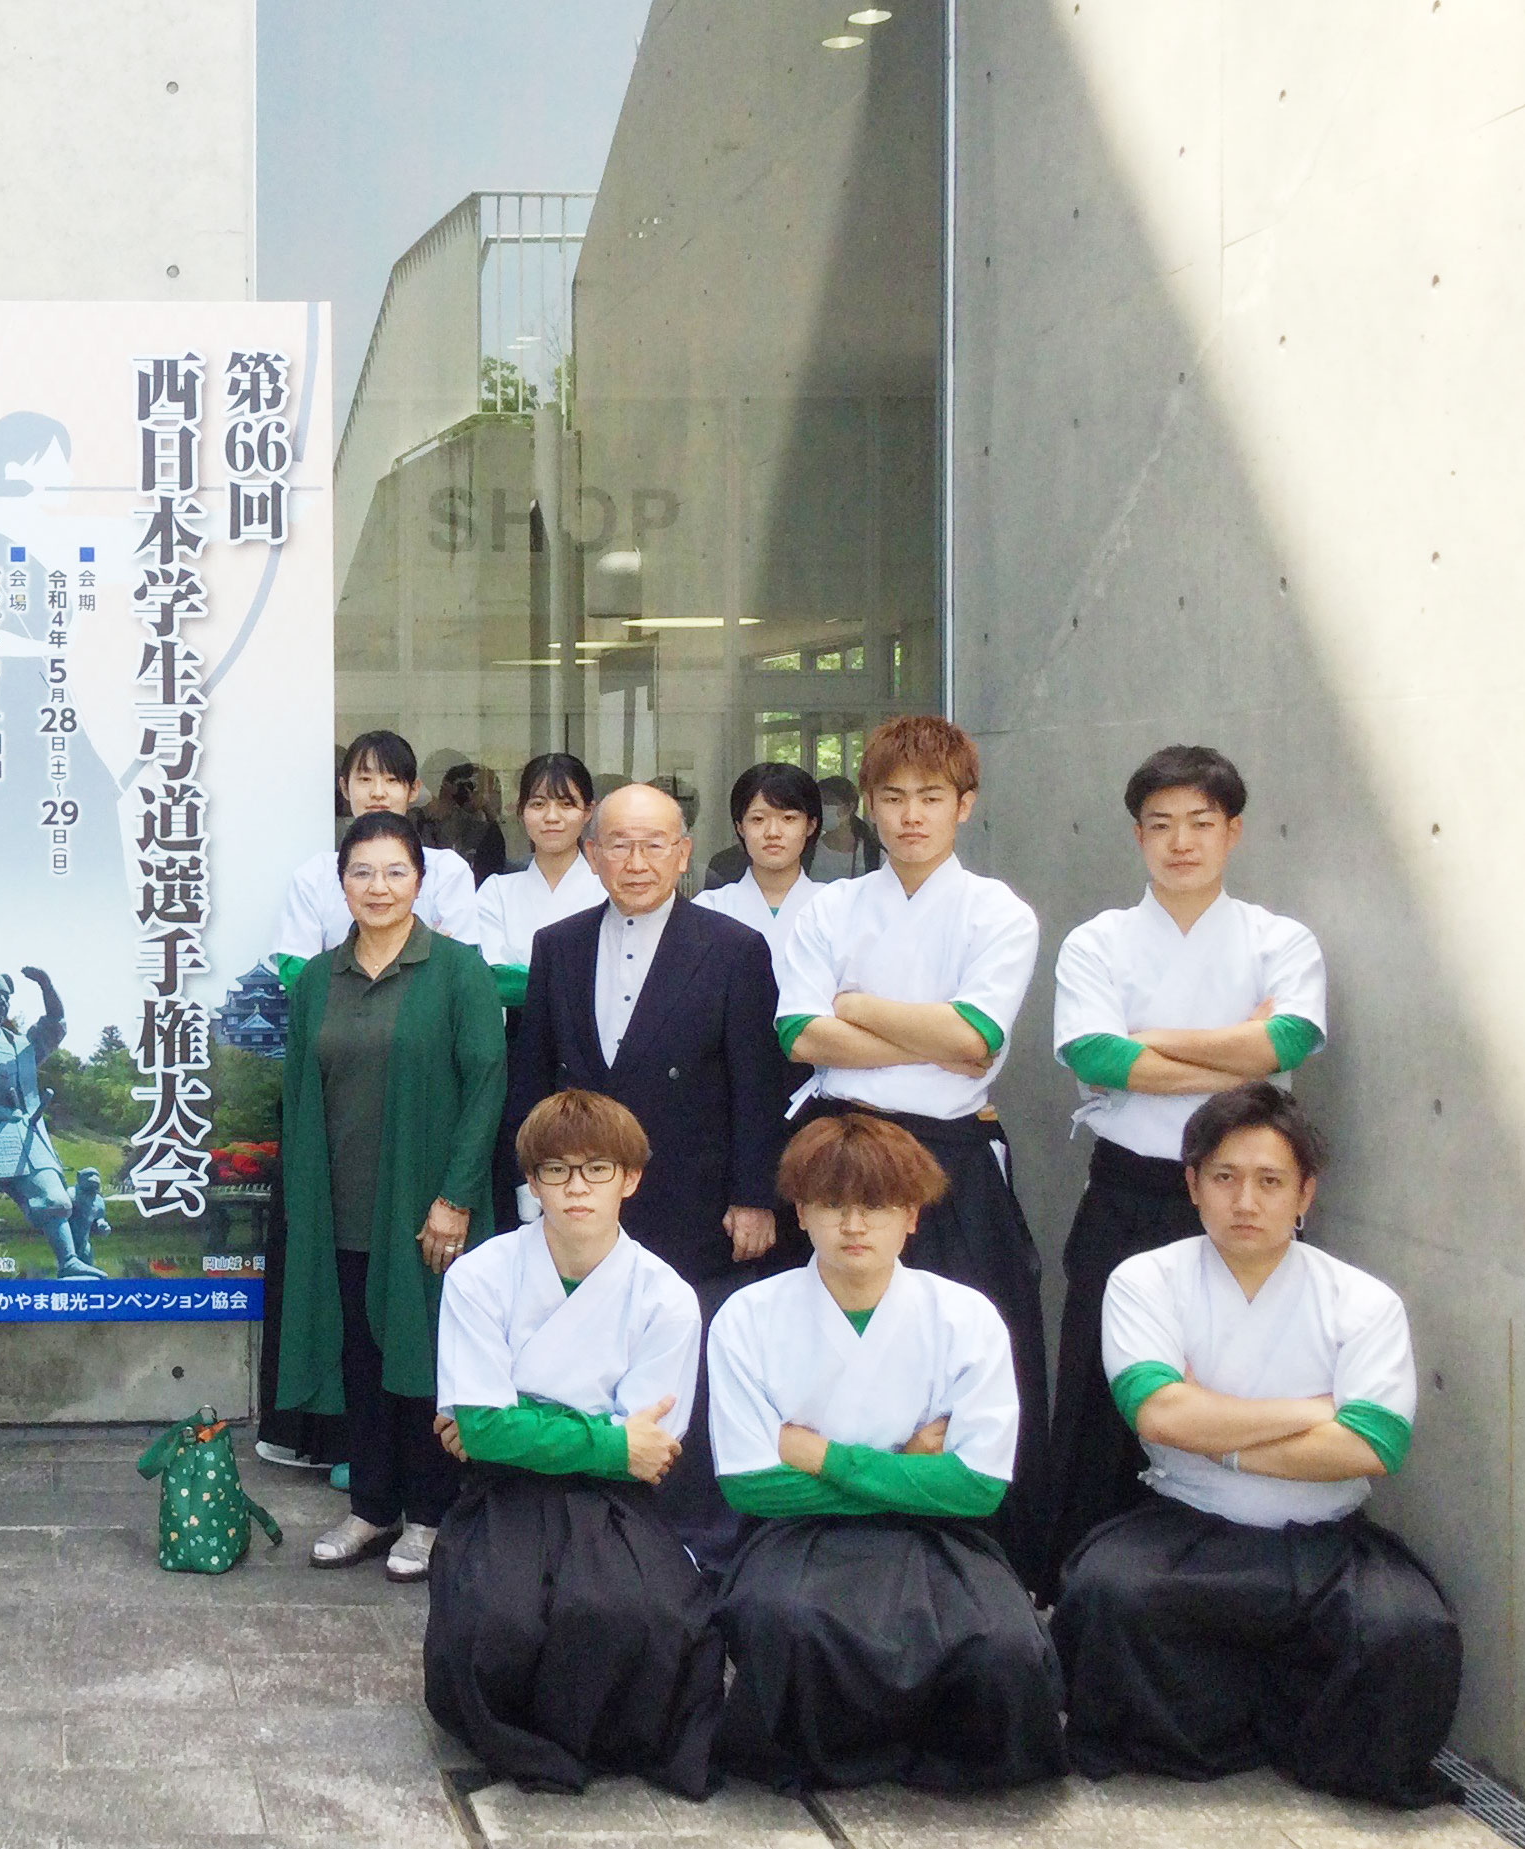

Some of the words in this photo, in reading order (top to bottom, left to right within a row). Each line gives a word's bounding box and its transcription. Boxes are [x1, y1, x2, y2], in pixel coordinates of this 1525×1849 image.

[225, 351, 290, 540] 第66回
[427, 485, 680, 554] SHOP
[8, 569, 28, 613] 会場
[78, 569, 97, 612] 会期
[134, 352, 208, 1212] 西日本学生弓道選手権大会
